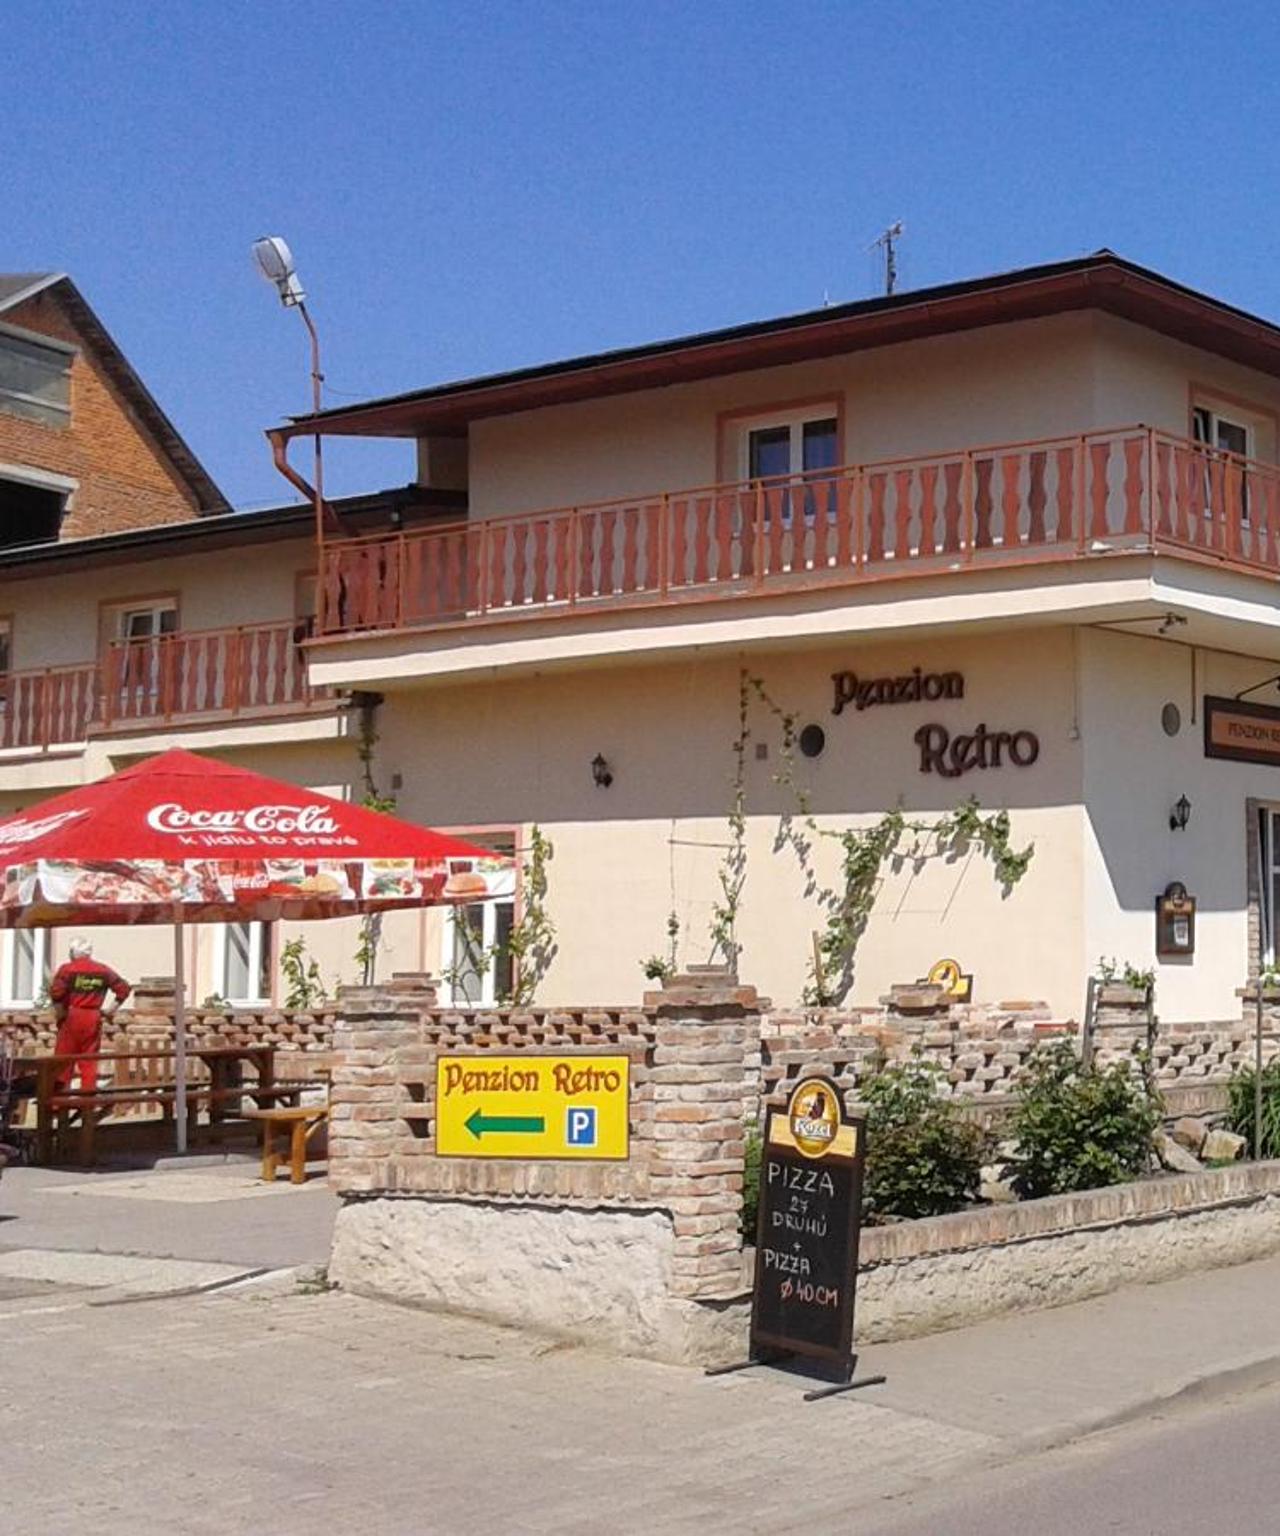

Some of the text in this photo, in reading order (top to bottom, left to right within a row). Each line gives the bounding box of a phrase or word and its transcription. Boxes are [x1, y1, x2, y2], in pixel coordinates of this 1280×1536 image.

[831, 667, 965, 715] Penzion
[914, 723, 1040, 778] Retro
[147, 803, 341, 833] Coca-Cola
[444, 1063, 621, 1097] Penzion Retro
[572, 1112, 590, 1141] P
[794, 1117, 832, 1140] Kozel
[768, 1162, 834, 1198] PIZZA
[764, 1249, 810, 1276] PIZZA
